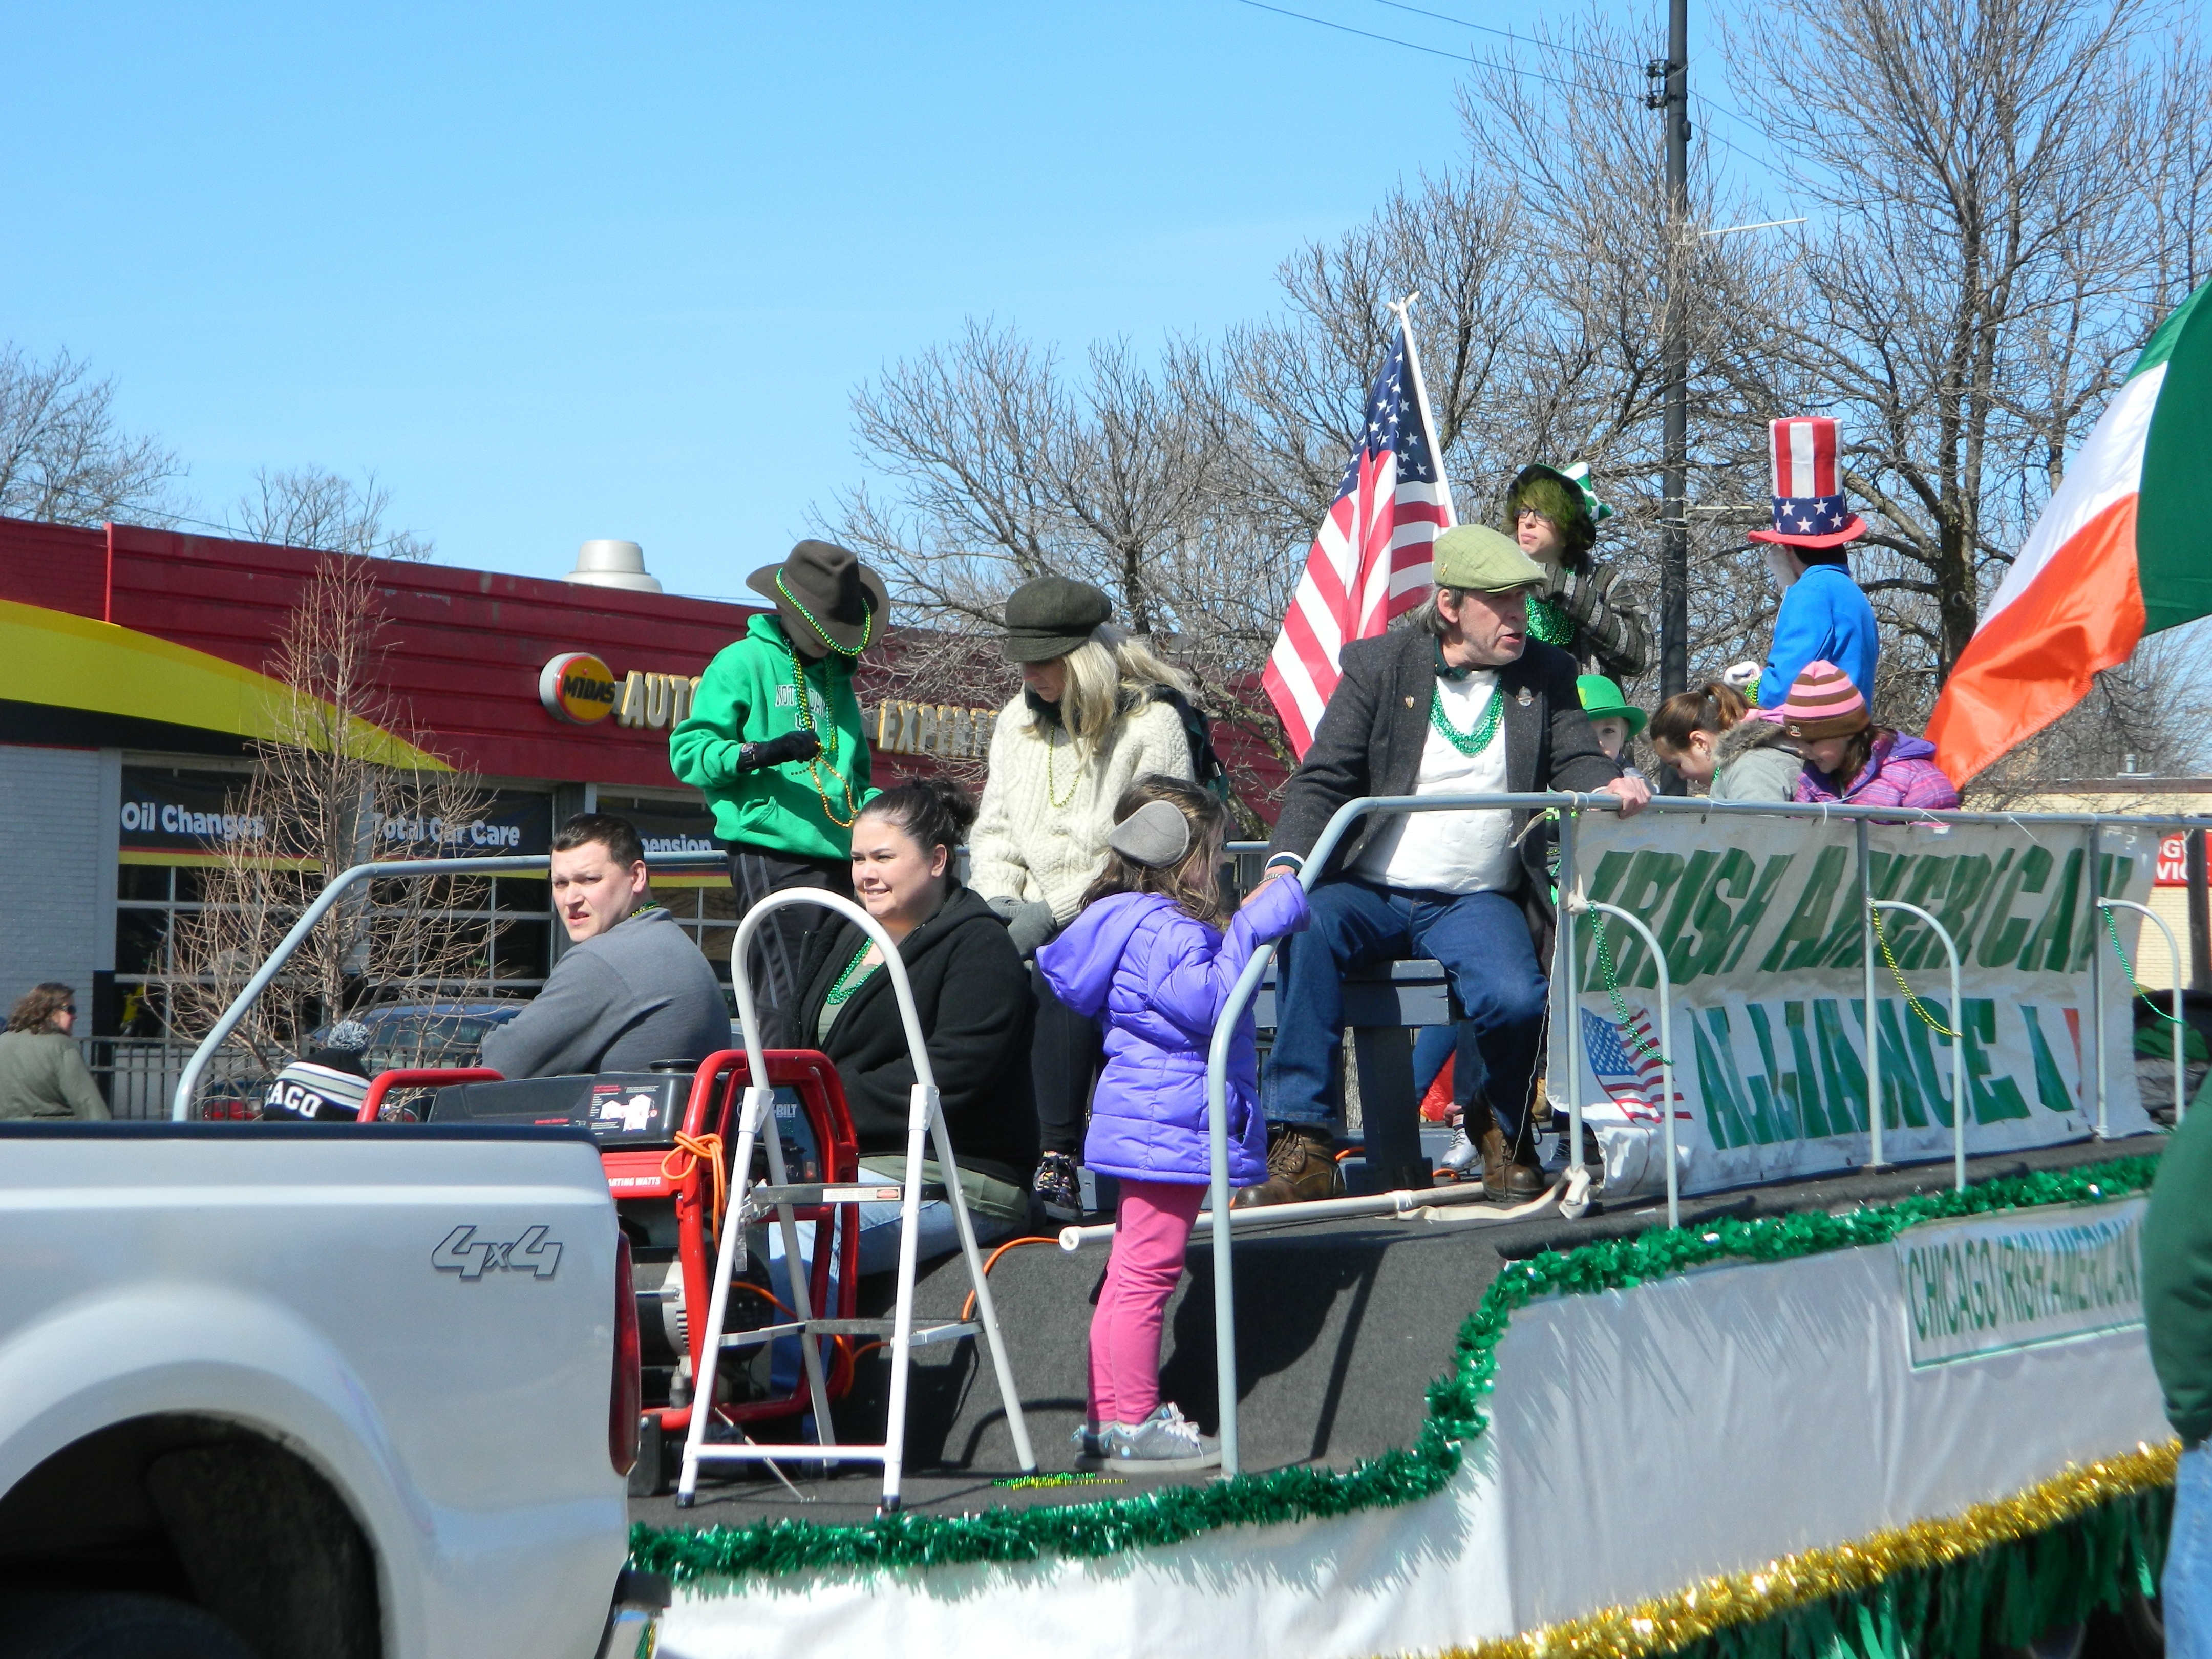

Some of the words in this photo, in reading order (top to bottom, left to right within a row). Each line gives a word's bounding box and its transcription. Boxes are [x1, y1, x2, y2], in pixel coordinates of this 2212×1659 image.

[564, 675, 614, 704] MIDAS
[121, 802, 155, 831] Oil
[162, 804, 266, 841] Changes
[471, 819, 520, 846] Care
[1575, 847, 1796, 993] IRISH
[1758, 845, 2134, 974] AMERICAN
[1685, 996, 2031, 1150] ALLIANCE
[635, 1176, 661, 1186] WATTS
[431, 1225, 563, 1280] 4x4
[1908, 1236, 1996, 1341] CHICAGO
